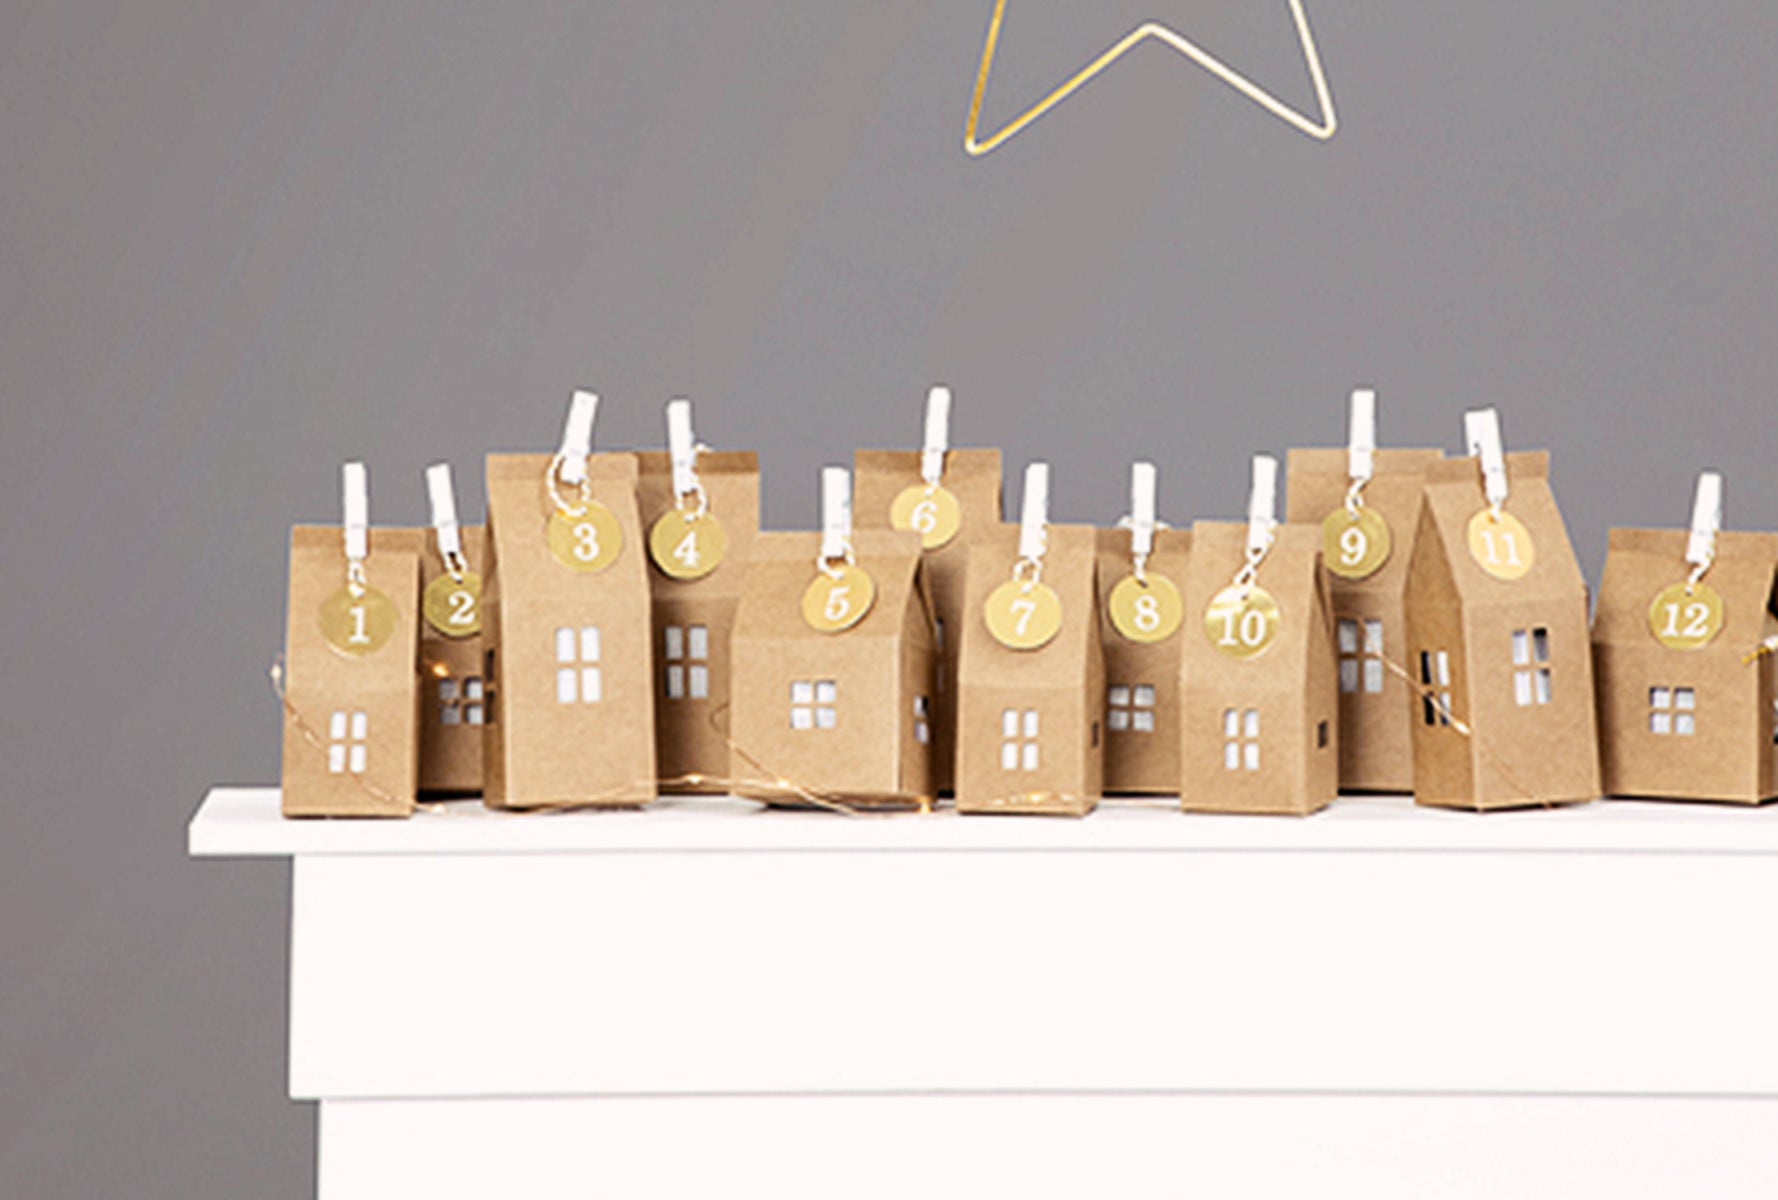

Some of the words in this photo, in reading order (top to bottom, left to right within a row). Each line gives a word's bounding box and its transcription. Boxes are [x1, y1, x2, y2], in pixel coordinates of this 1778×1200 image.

[911, 502, 937, 533] 6
[572, 523, 599, 561] 3
[673, 530, 700, 566] 4
[1340, 528, 1367, 566] 9
[1480, 530, 1521, 567] 11
[448, 590, 475, 625] 2
[824, 586, 849, 620] 5
[1010, 600, 1035, 636] 7
[1133, 594, 1160, 630] 8
[1660, 603, 1709, 638] 12
[348, 606, 370, 643] 1
[1217, 608, 1266, 646] 10
